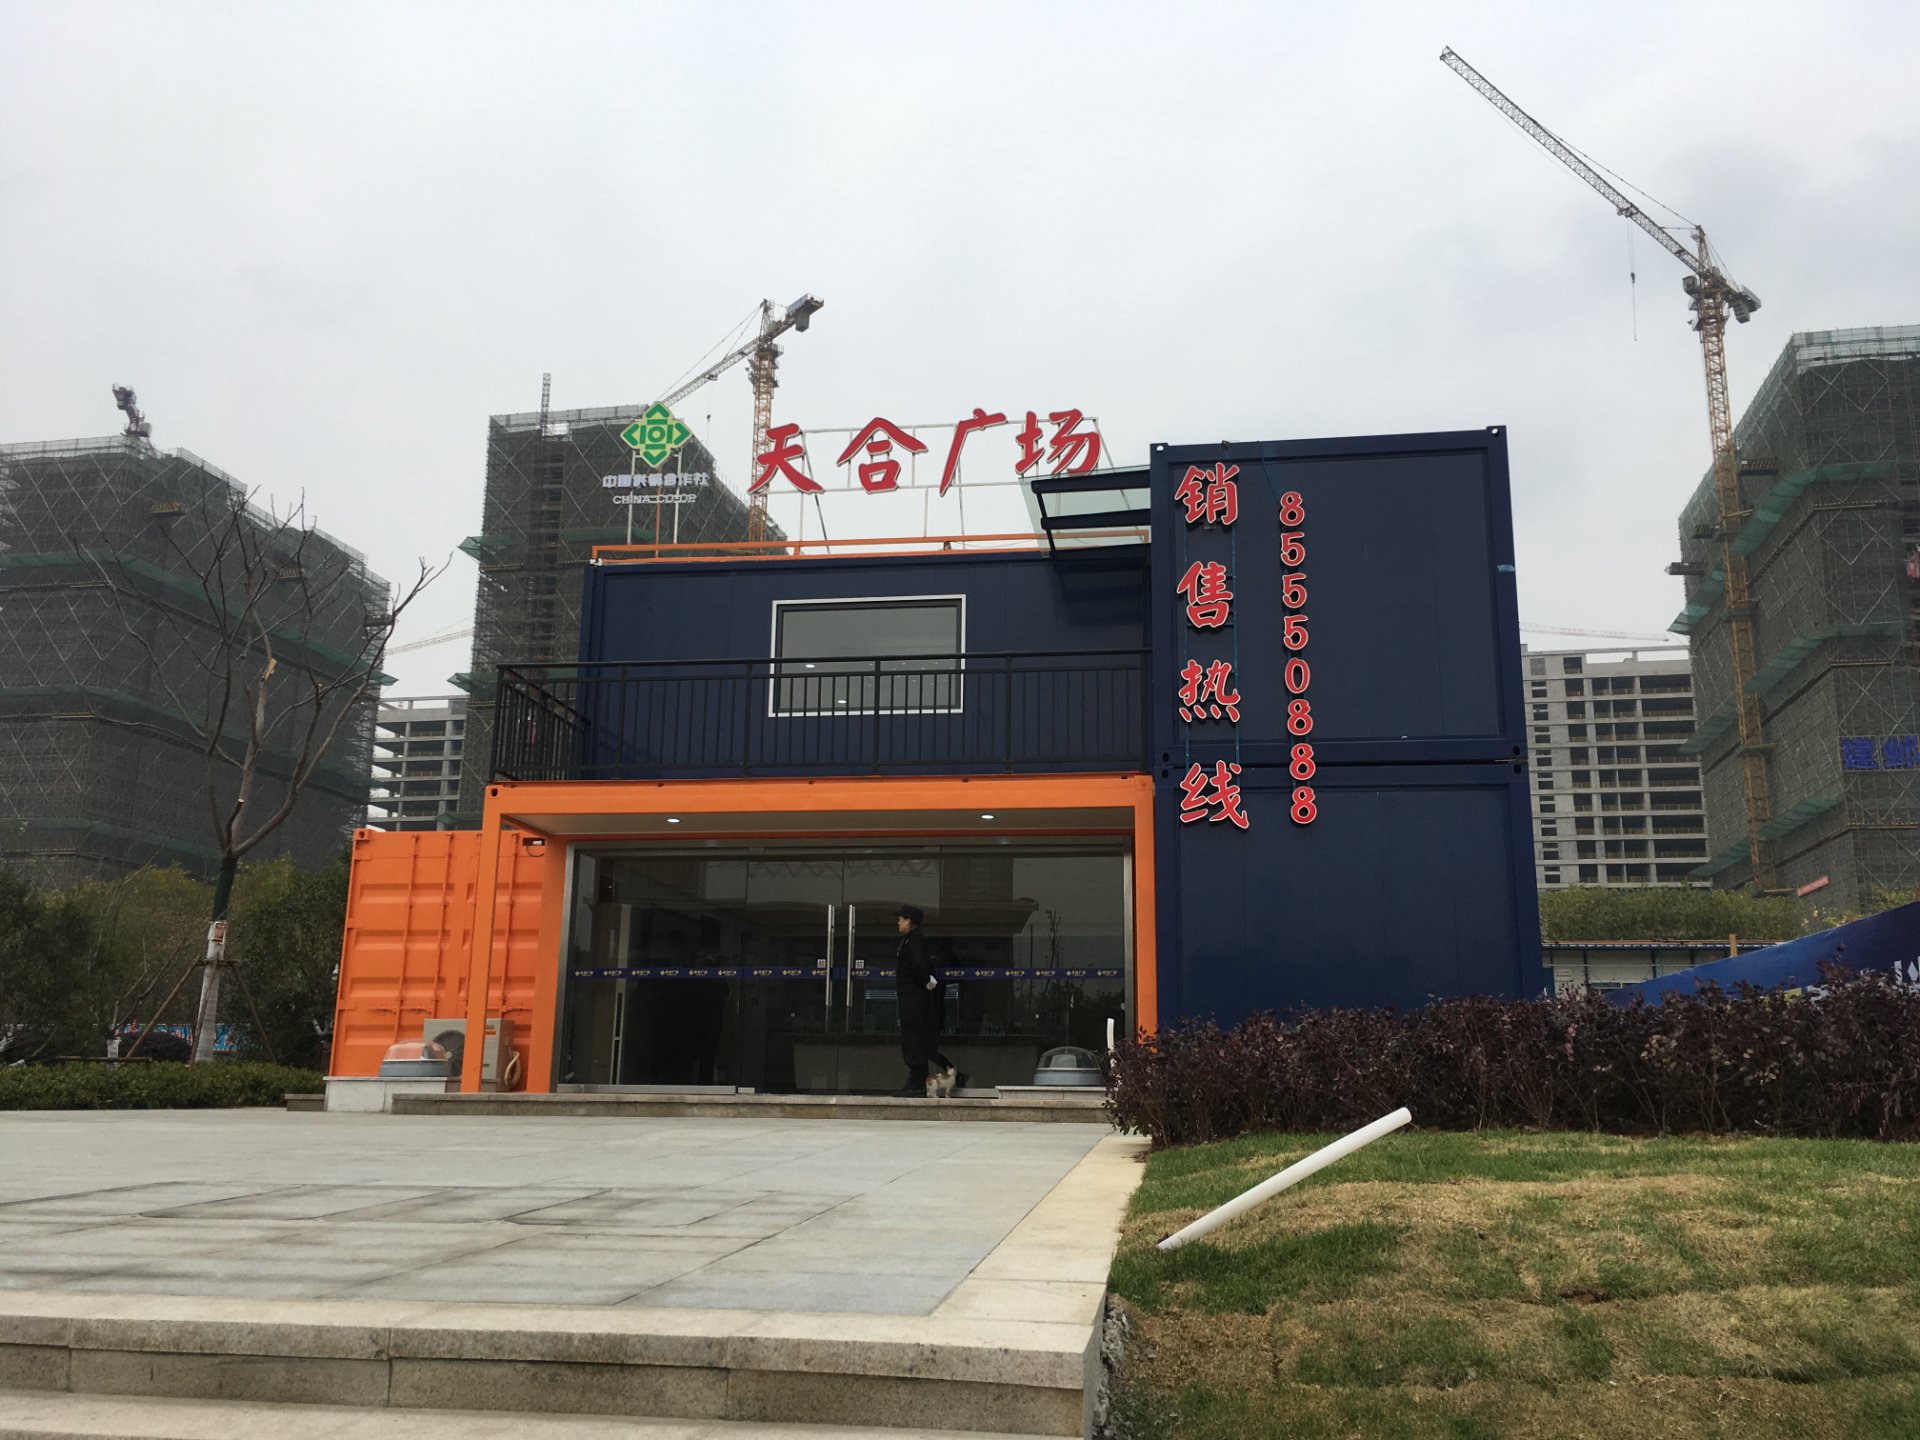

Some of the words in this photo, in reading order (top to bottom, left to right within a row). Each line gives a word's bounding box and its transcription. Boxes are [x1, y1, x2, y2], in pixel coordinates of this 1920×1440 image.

[612, 494, 652, 505] CHINA
[747, 408, 1102, 497] 天合广场
[1175, 462, 1250, 830] 销售热线
[1279, 491, 1318, 825] 85550888
